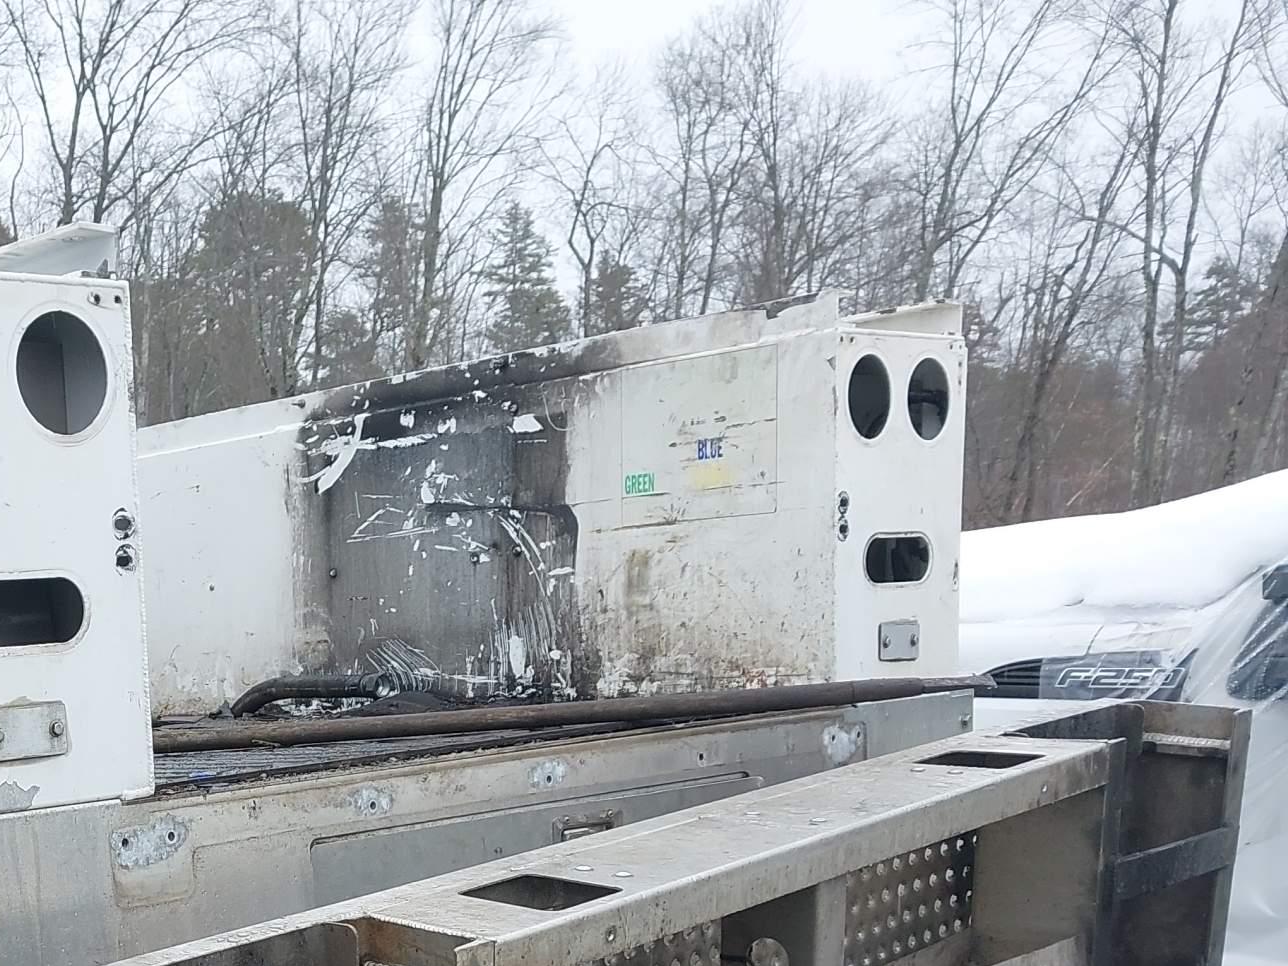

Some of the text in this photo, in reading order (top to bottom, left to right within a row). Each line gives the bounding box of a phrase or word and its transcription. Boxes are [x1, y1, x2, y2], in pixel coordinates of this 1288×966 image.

[697, 438, 723, 460] BLUE
[625, 473, 654, 494] GREEN
[1055, 667, 1185, 689] F-250
